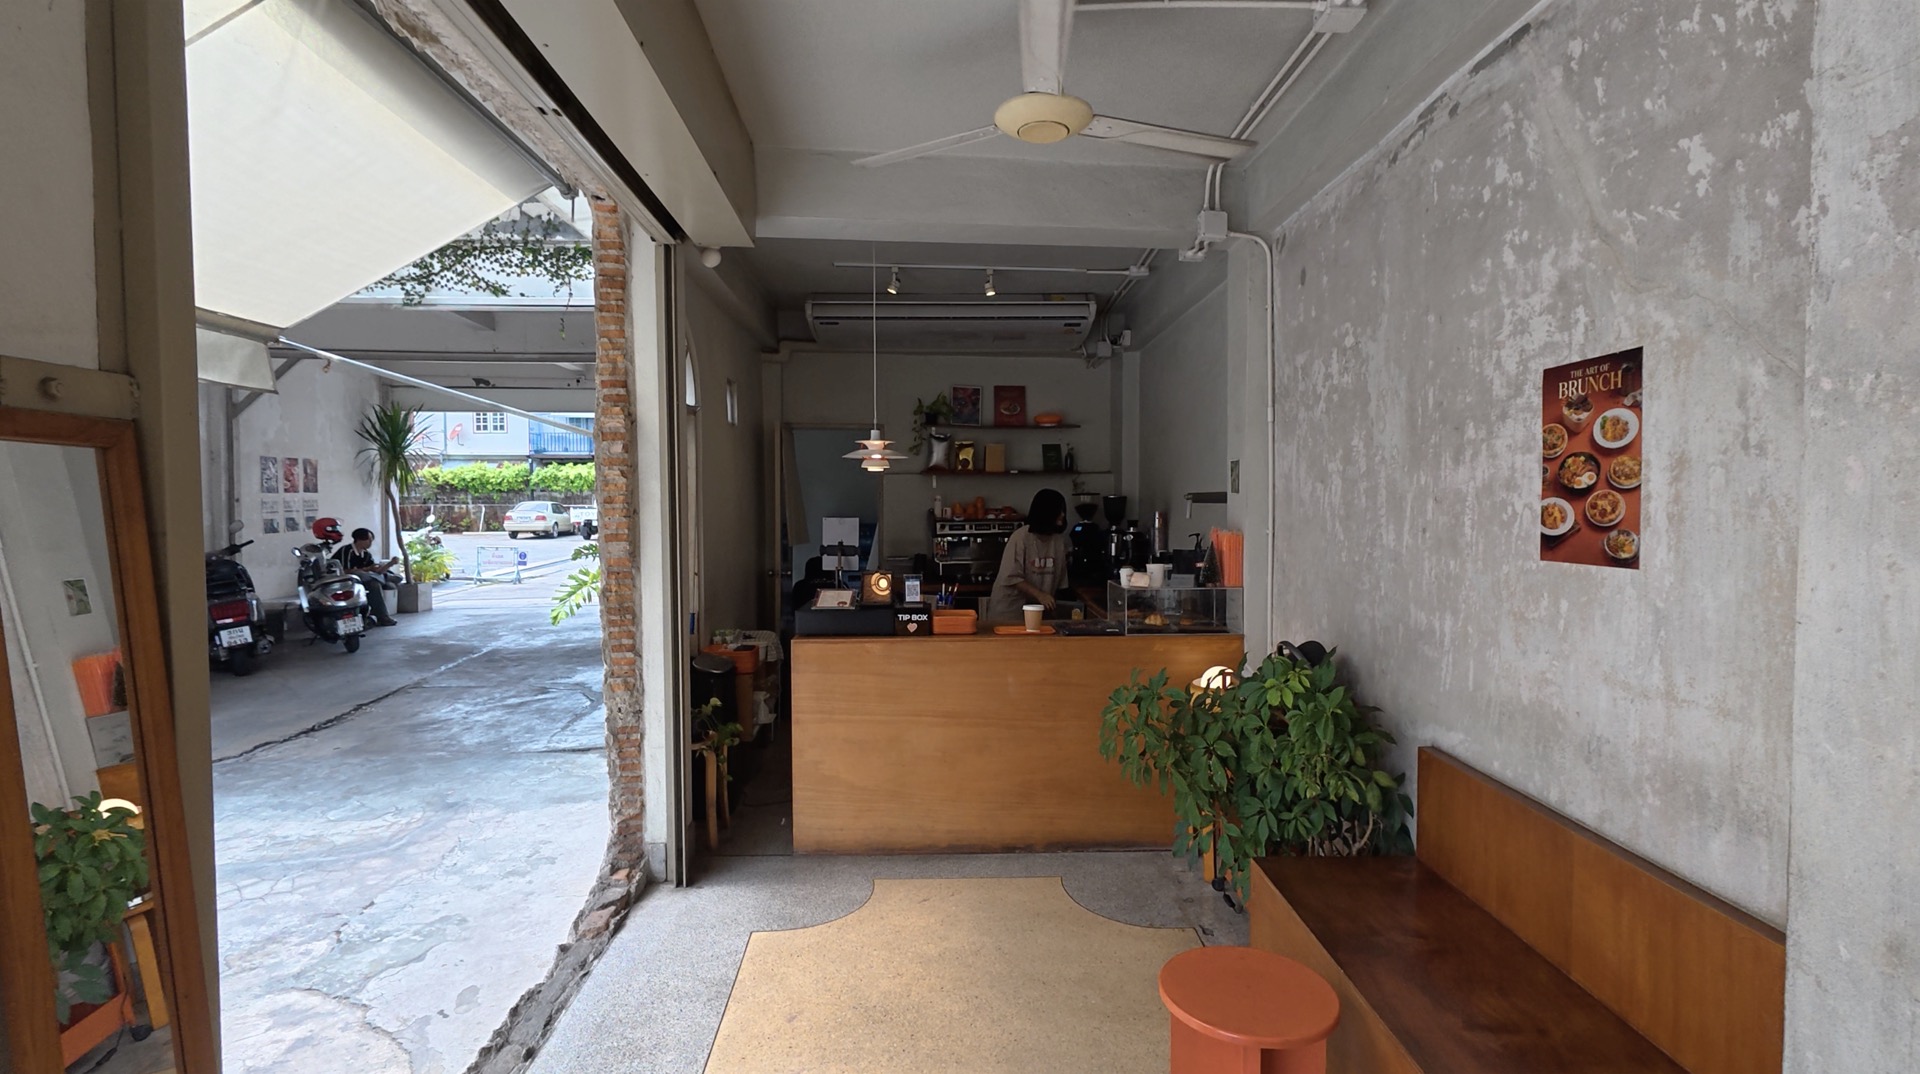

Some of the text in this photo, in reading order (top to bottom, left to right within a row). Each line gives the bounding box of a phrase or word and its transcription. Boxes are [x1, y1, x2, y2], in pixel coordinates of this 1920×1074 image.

[1570, 363, 1611, 379] THE ART OF
[1558, 370, 1623, 400] BRUNCH
